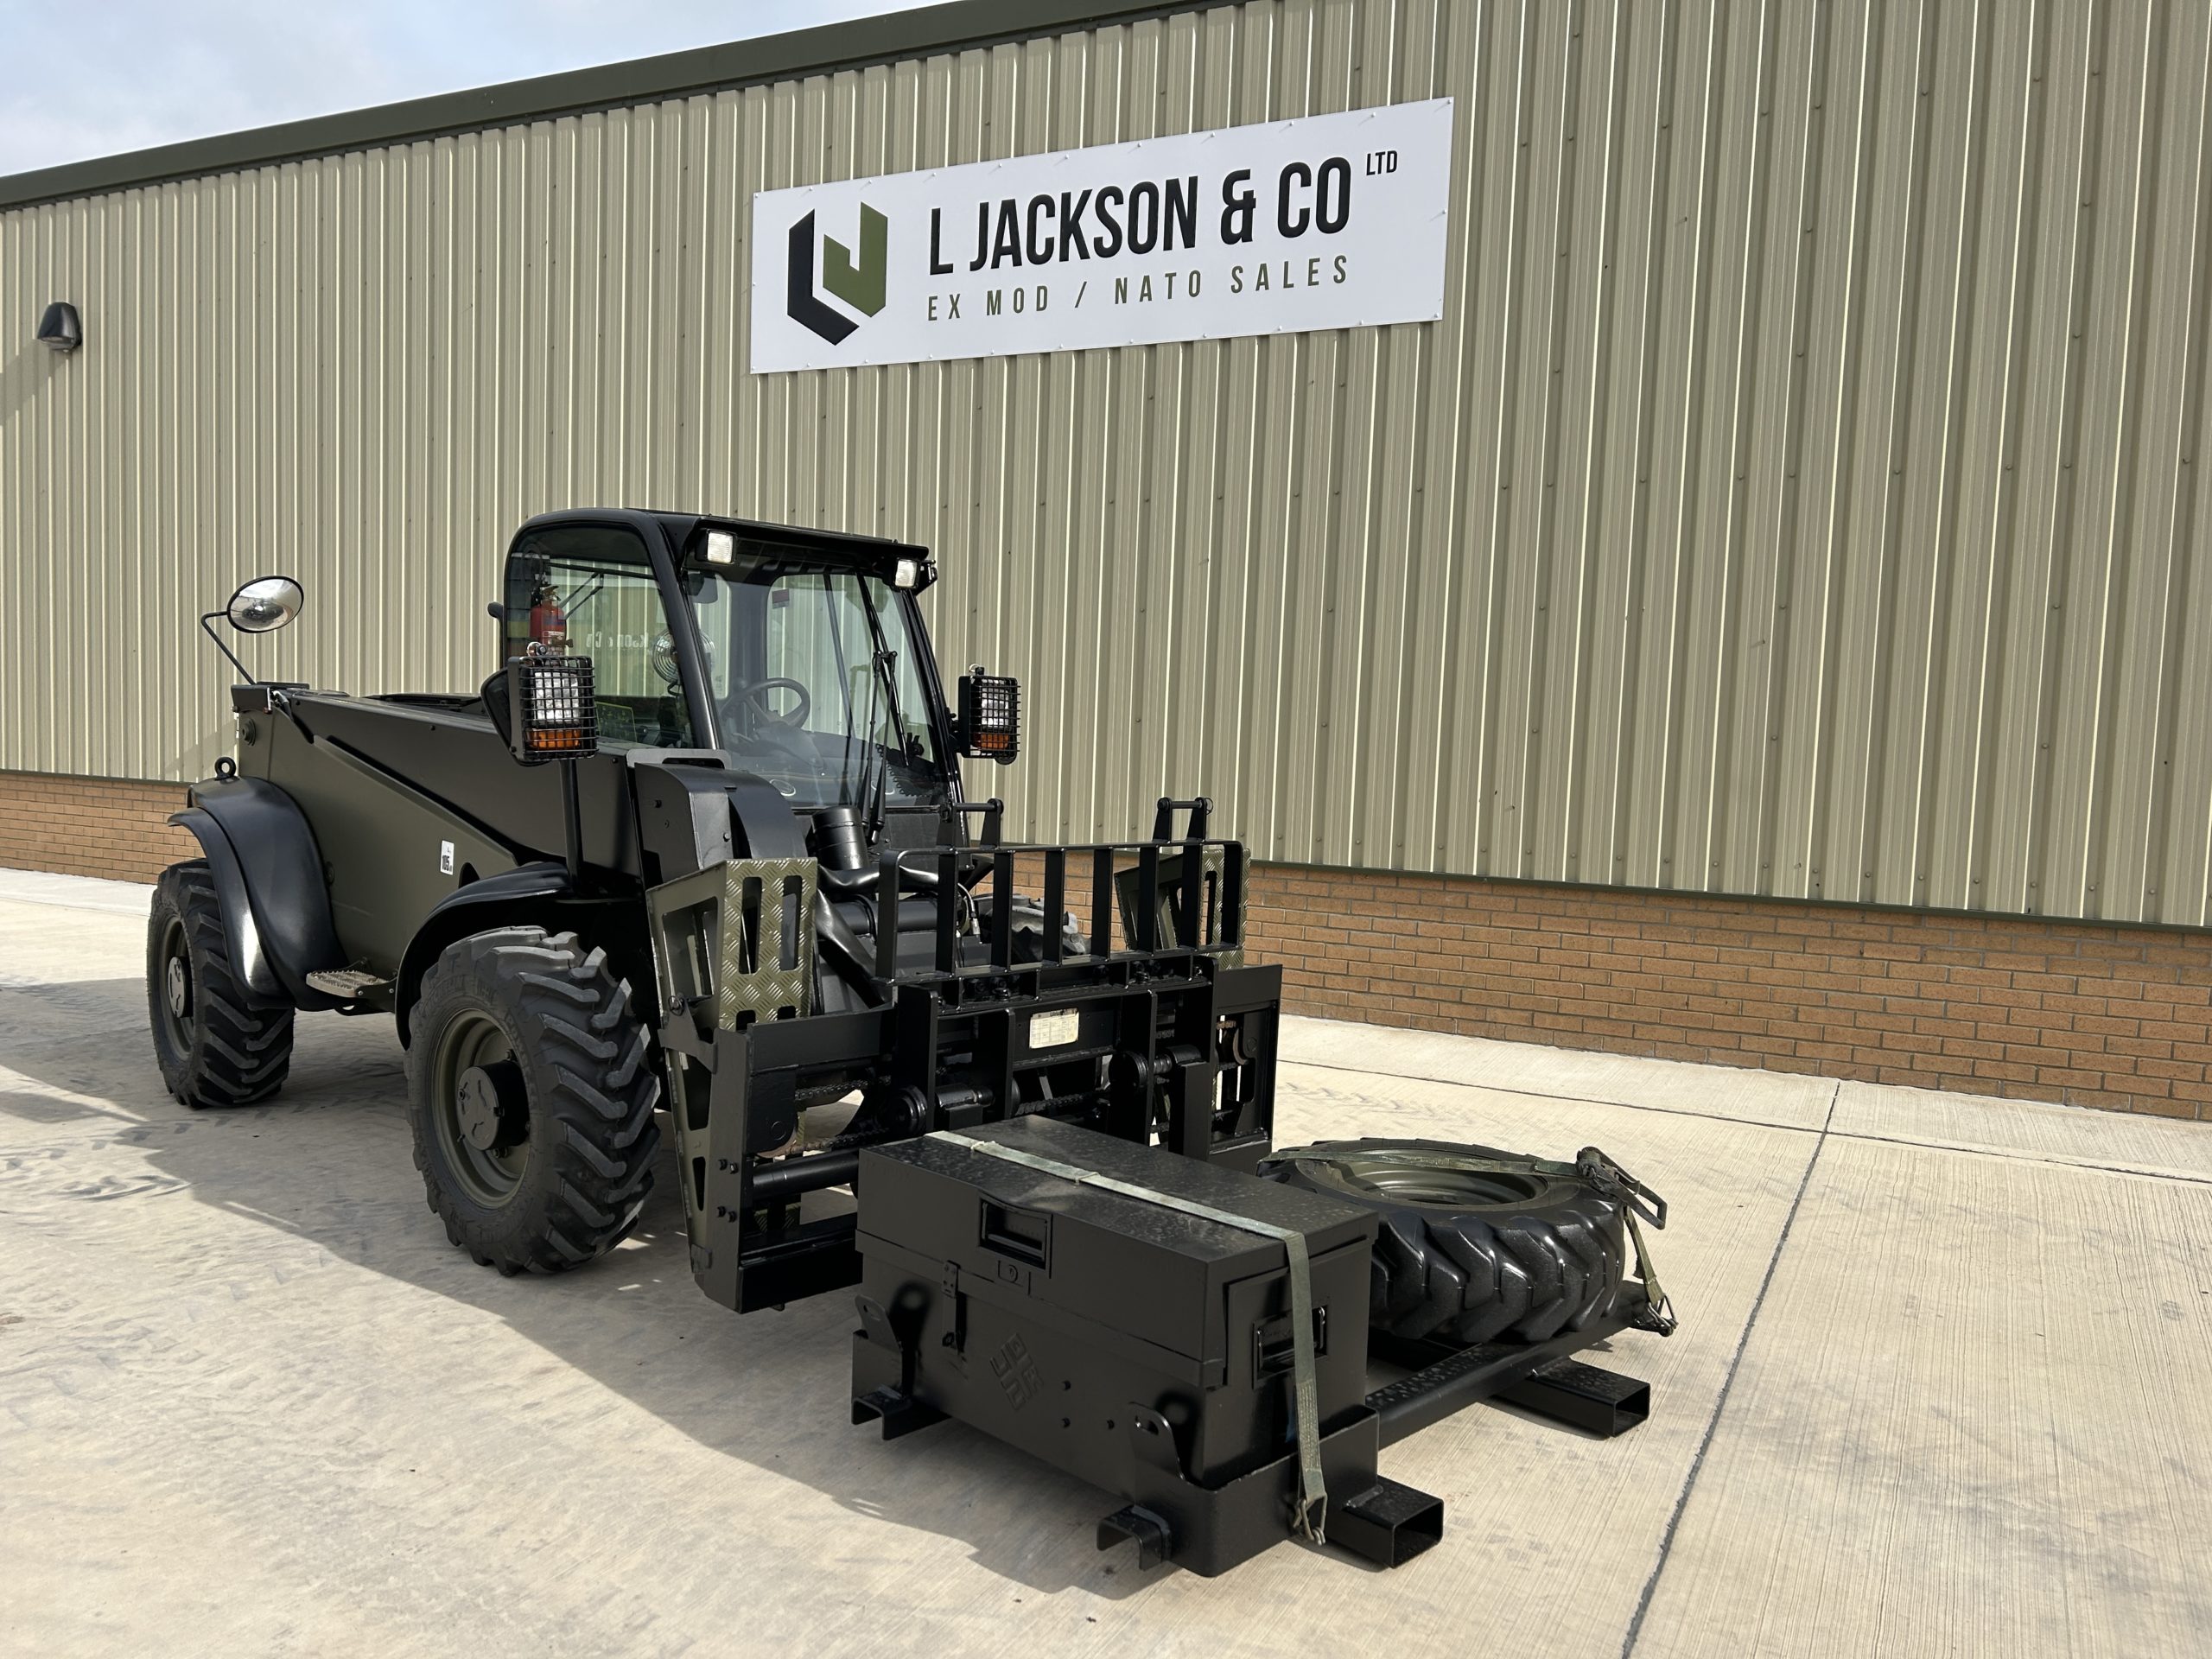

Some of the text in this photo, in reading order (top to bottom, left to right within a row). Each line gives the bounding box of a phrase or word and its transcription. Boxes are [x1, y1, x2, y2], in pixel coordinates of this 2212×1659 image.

[928, 149, 1398, 276] L JACKSON & CO LTD
[928, 255, 1347, 321] EX MOD / NATO SALES
